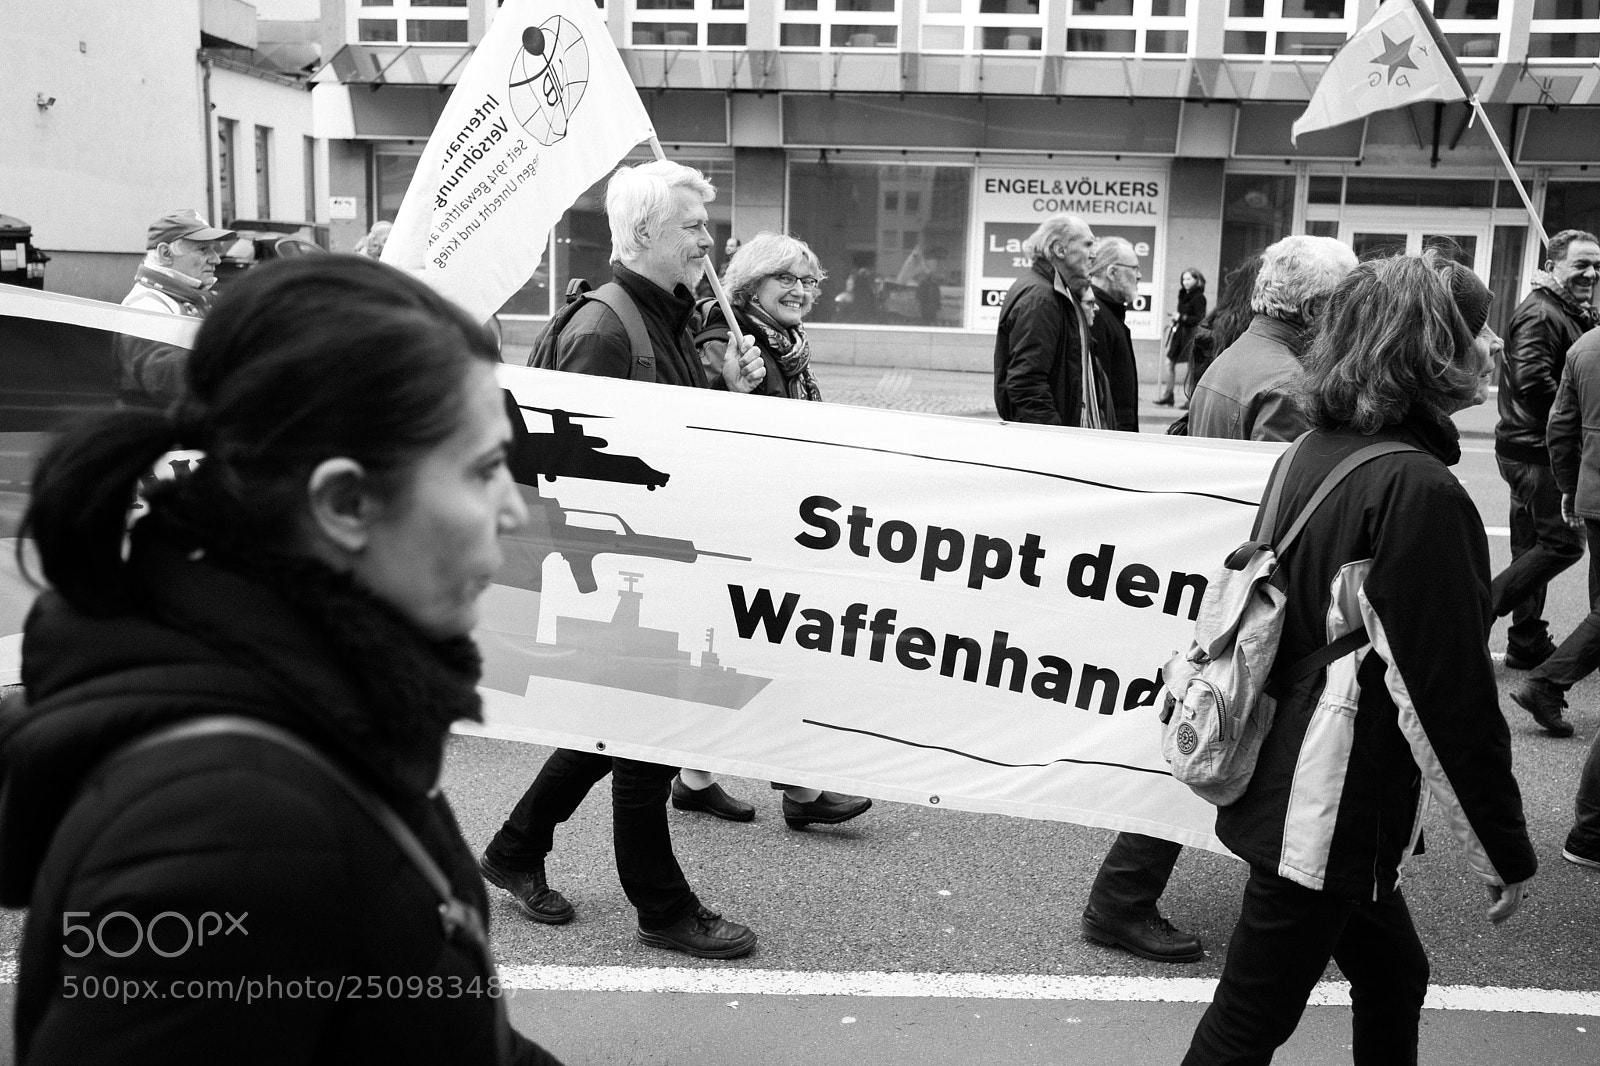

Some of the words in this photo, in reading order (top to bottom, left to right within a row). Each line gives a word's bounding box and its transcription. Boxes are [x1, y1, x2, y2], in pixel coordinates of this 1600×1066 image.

[1033, 198, 1157, 215] COMMERCIAL
[794, 495, 1046, 590] Stoppt
[1066, 544, 1210, 622] den
